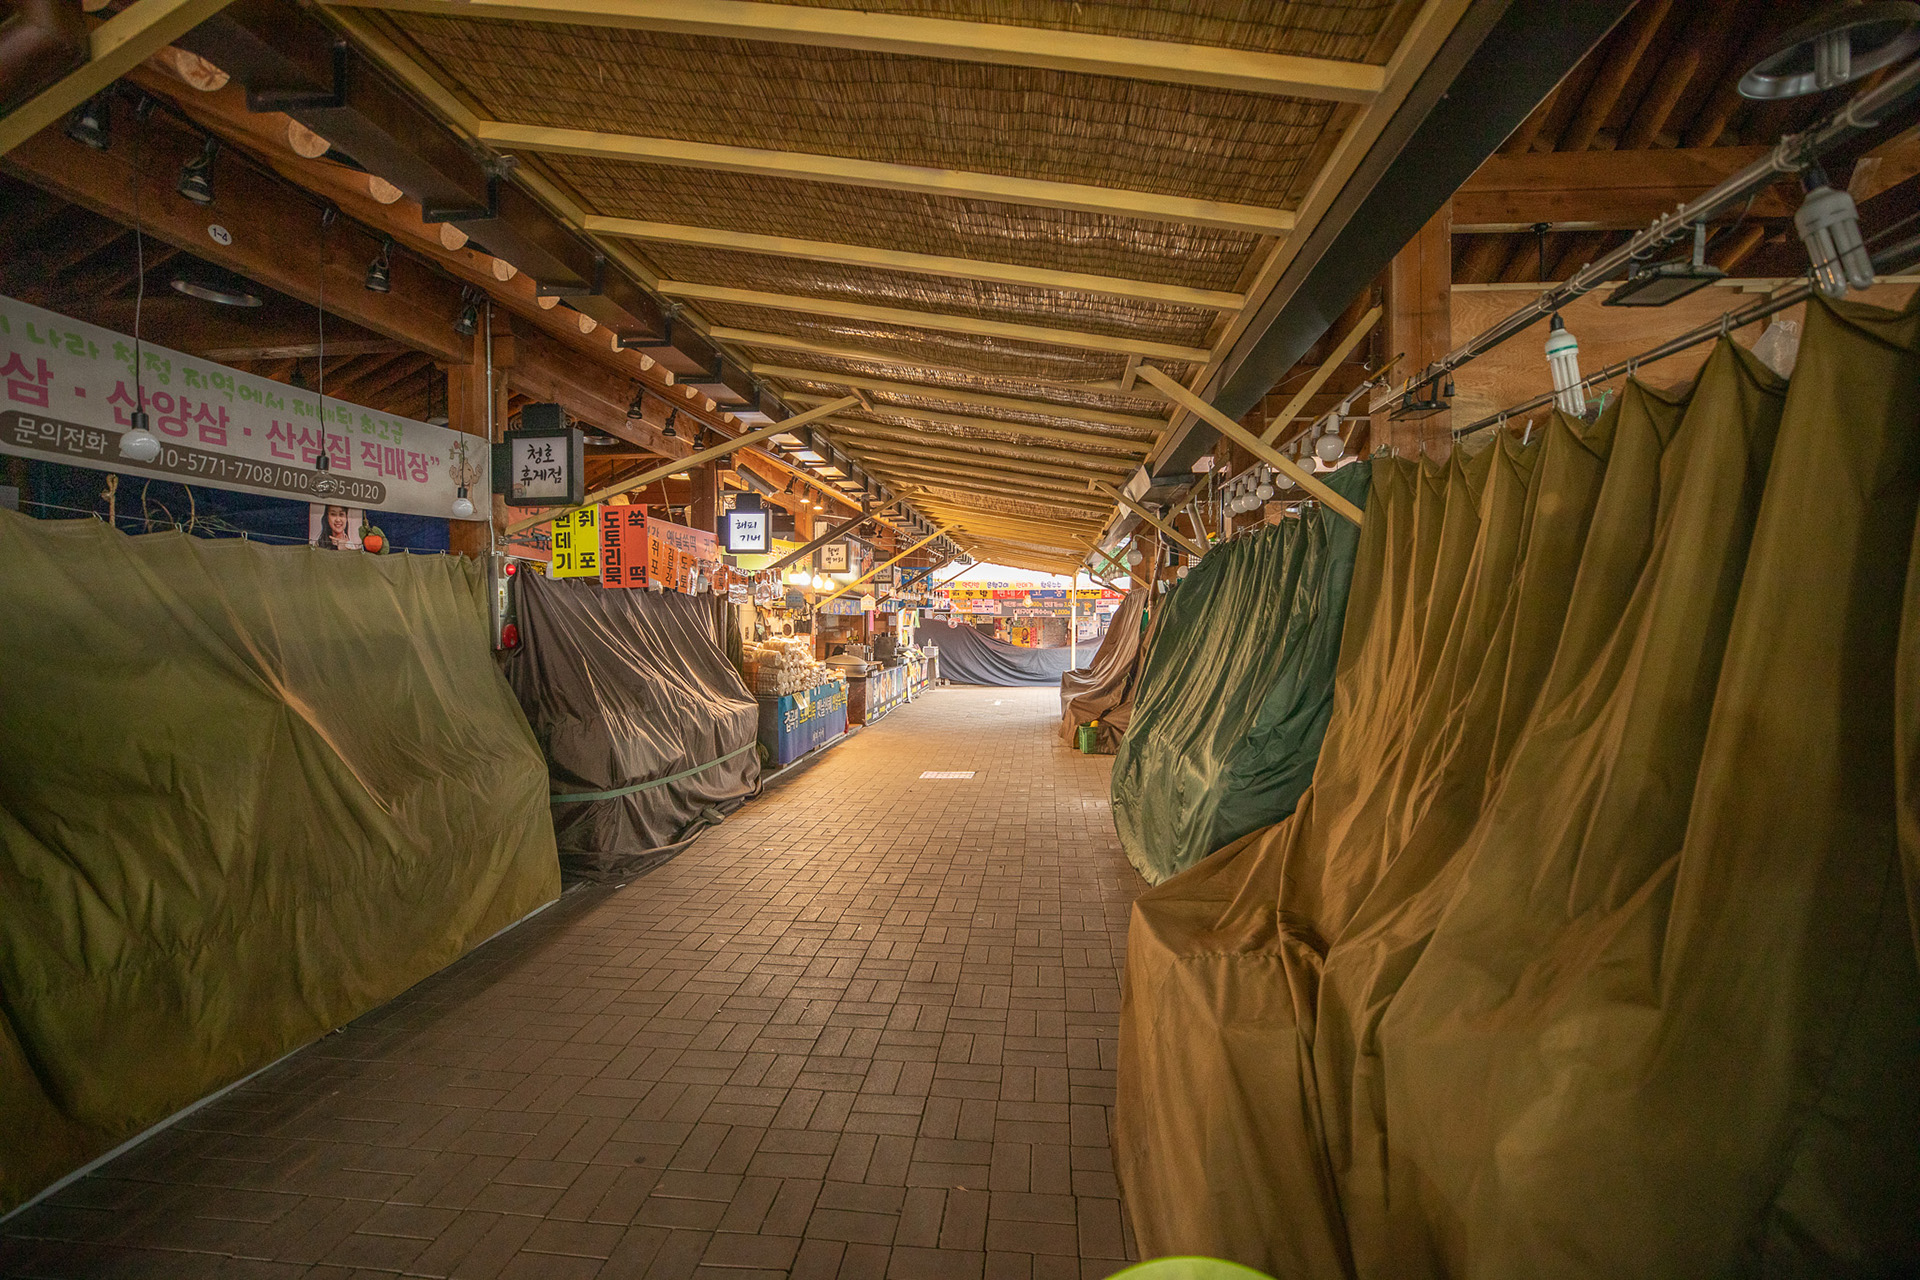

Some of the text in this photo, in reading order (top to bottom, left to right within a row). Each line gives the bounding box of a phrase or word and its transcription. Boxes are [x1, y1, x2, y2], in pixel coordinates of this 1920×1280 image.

[213, 227, 228, 242] 1-4
[0, 351, 55, 409] 삼
[106, 380, 231, 447] 산양삼
[265, 419, 352, 471] 산삼집
[25, 321, 100, 361] 나라
[112, 340, 172, 386] 청정
[182, 367, 285, 412] 지역에서
[292, 398, 354, 434] 재배된
[360, 413, 405, 445] 최고급
[14, 416, 109, 455] 문의전화
[527, 443, 555, 464] 청호
[578, 509, 596, 569] 쥐포
[604, 511, 622, 585] 도토리묵
[627, 510, 646, 584] 쑥떡
